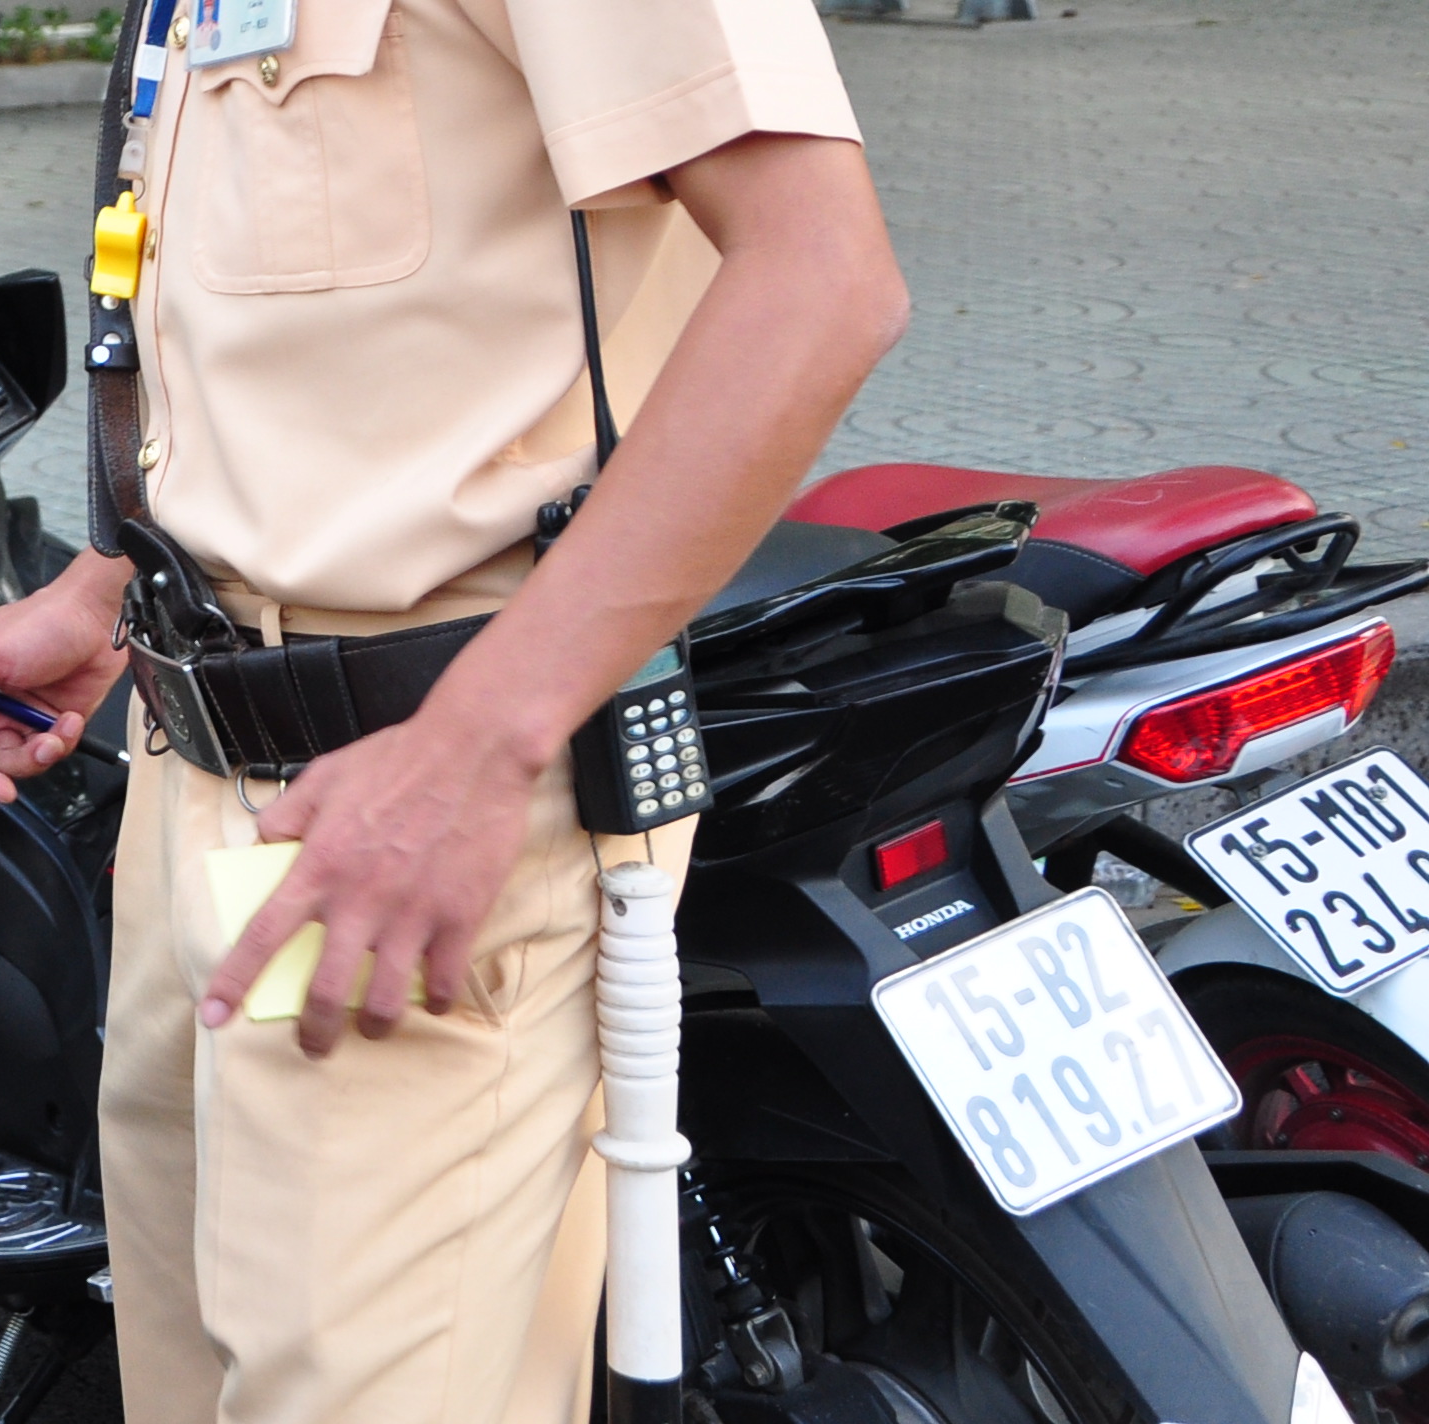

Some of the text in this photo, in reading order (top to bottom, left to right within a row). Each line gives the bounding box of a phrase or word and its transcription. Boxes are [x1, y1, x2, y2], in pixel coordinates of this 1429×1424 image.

[893, 899, 975, 940] HONDA
[925, 921, 1131, 1071] 15-B2
[966, 1007, 1204, 1188] 819.27
